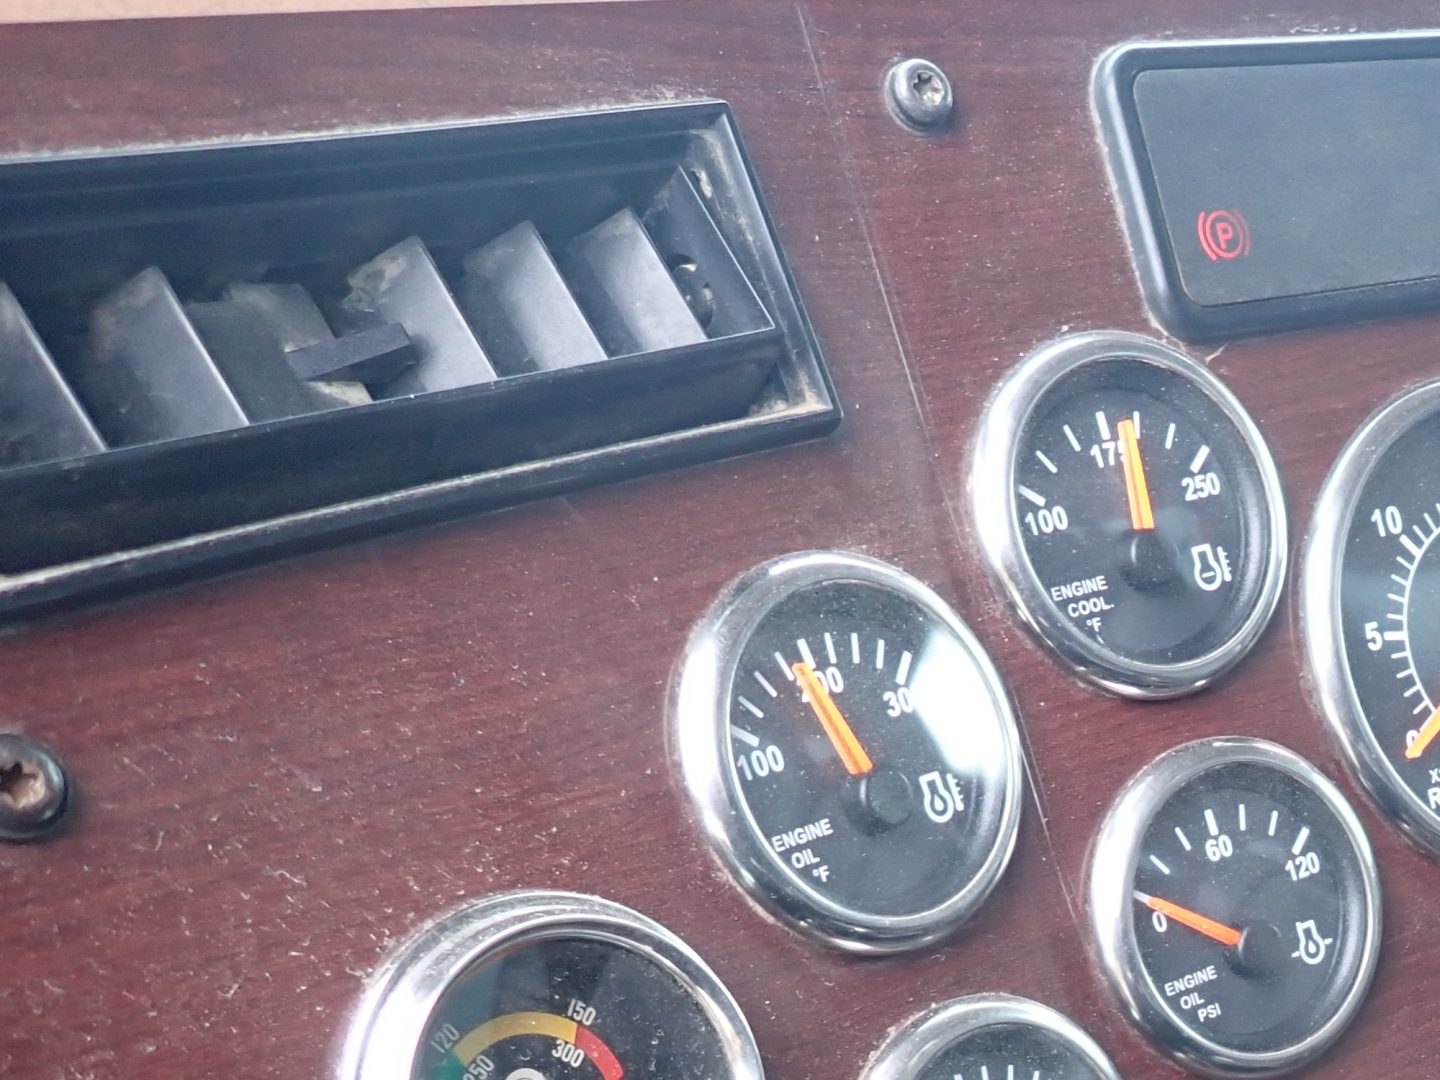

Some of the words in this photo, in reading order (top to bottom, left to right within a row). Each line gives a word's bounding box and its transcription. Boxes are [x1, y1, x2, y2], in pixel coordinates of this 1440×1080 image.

[1181, 472, 1221, 501] 250
[1025, 506, 1069, 536] 100
[1370, 505, 1403, 537] 10
[1051, 576, 1108, 601] ENGINE
[1067, 596, 1115, 618] COOL.
[1365, 622, 1383, 651] 5
[737, 745, 785, 781] 100
[772, 818, 834, 852] ENGINE
[1205, 834, 1233, 862] 60
[791, 849, 821, 869] OIL
[1285, 852, 1321, 881] 120
[1152, 911, 1168, 933] 0
[1164, 965, 1218, 997] ENGINE
[566, 999, 596, 1026] 150
[1180, 992, 1205, 1010] OIL
[1197, 1003, 1221, 1022] PSI
[431, 1023, 460, 1054] 120
[551, 1040, 585, 1068] 300
